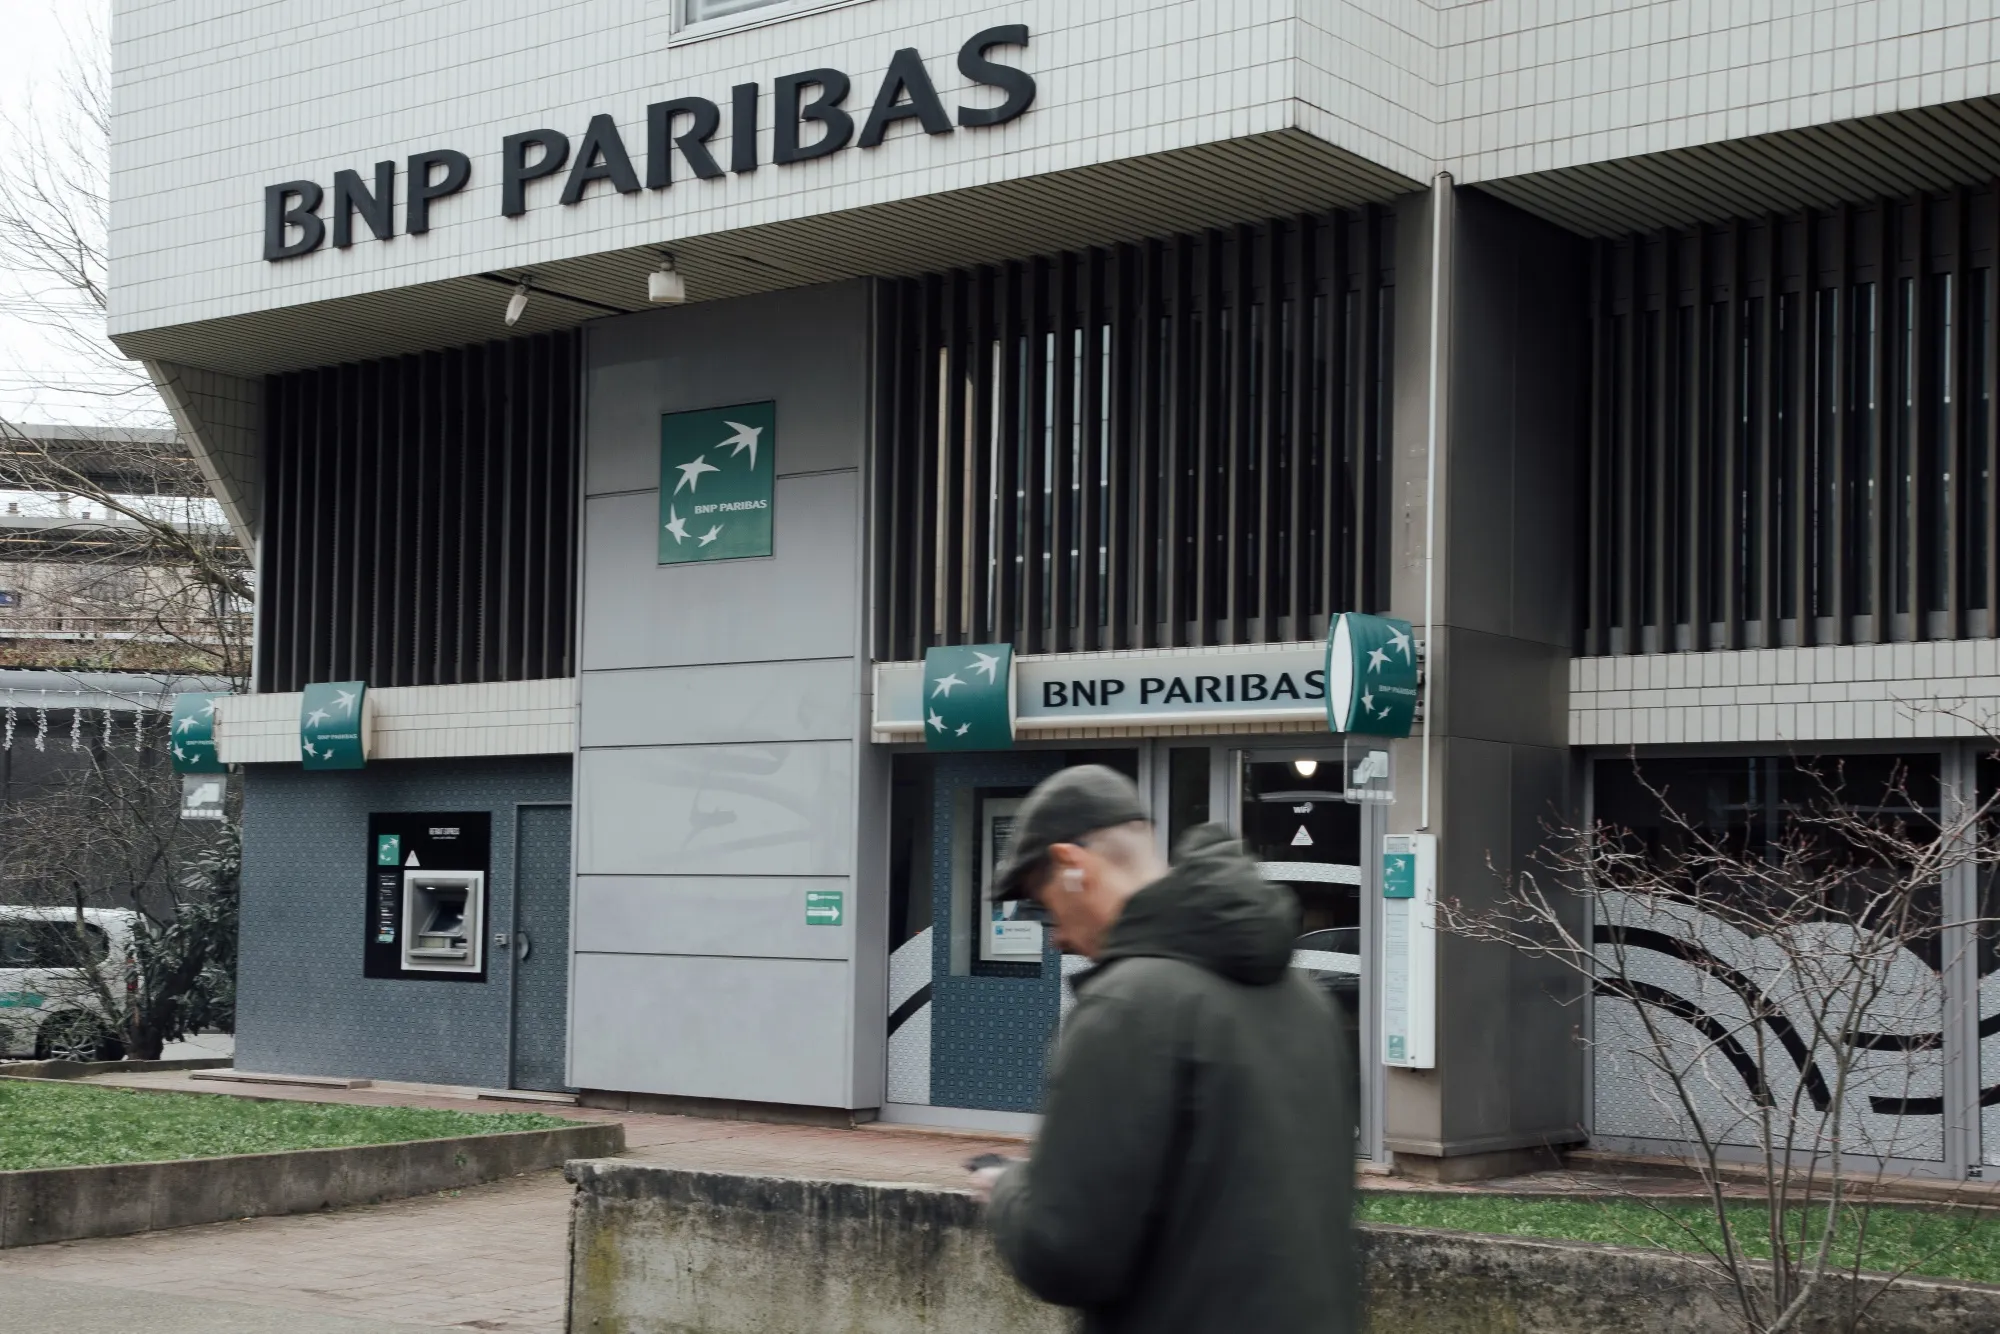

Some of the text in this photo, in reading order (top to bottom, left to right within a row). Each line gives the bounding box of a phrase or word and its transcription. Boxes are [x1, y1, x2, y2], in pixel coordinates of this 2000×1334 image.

[264, 24, 1037, 262] BNP PARIBAS
[694, 499, 767, 514] BNP PARIBAS
[1042, 669, 1326, 707] BNP PARIBAS
